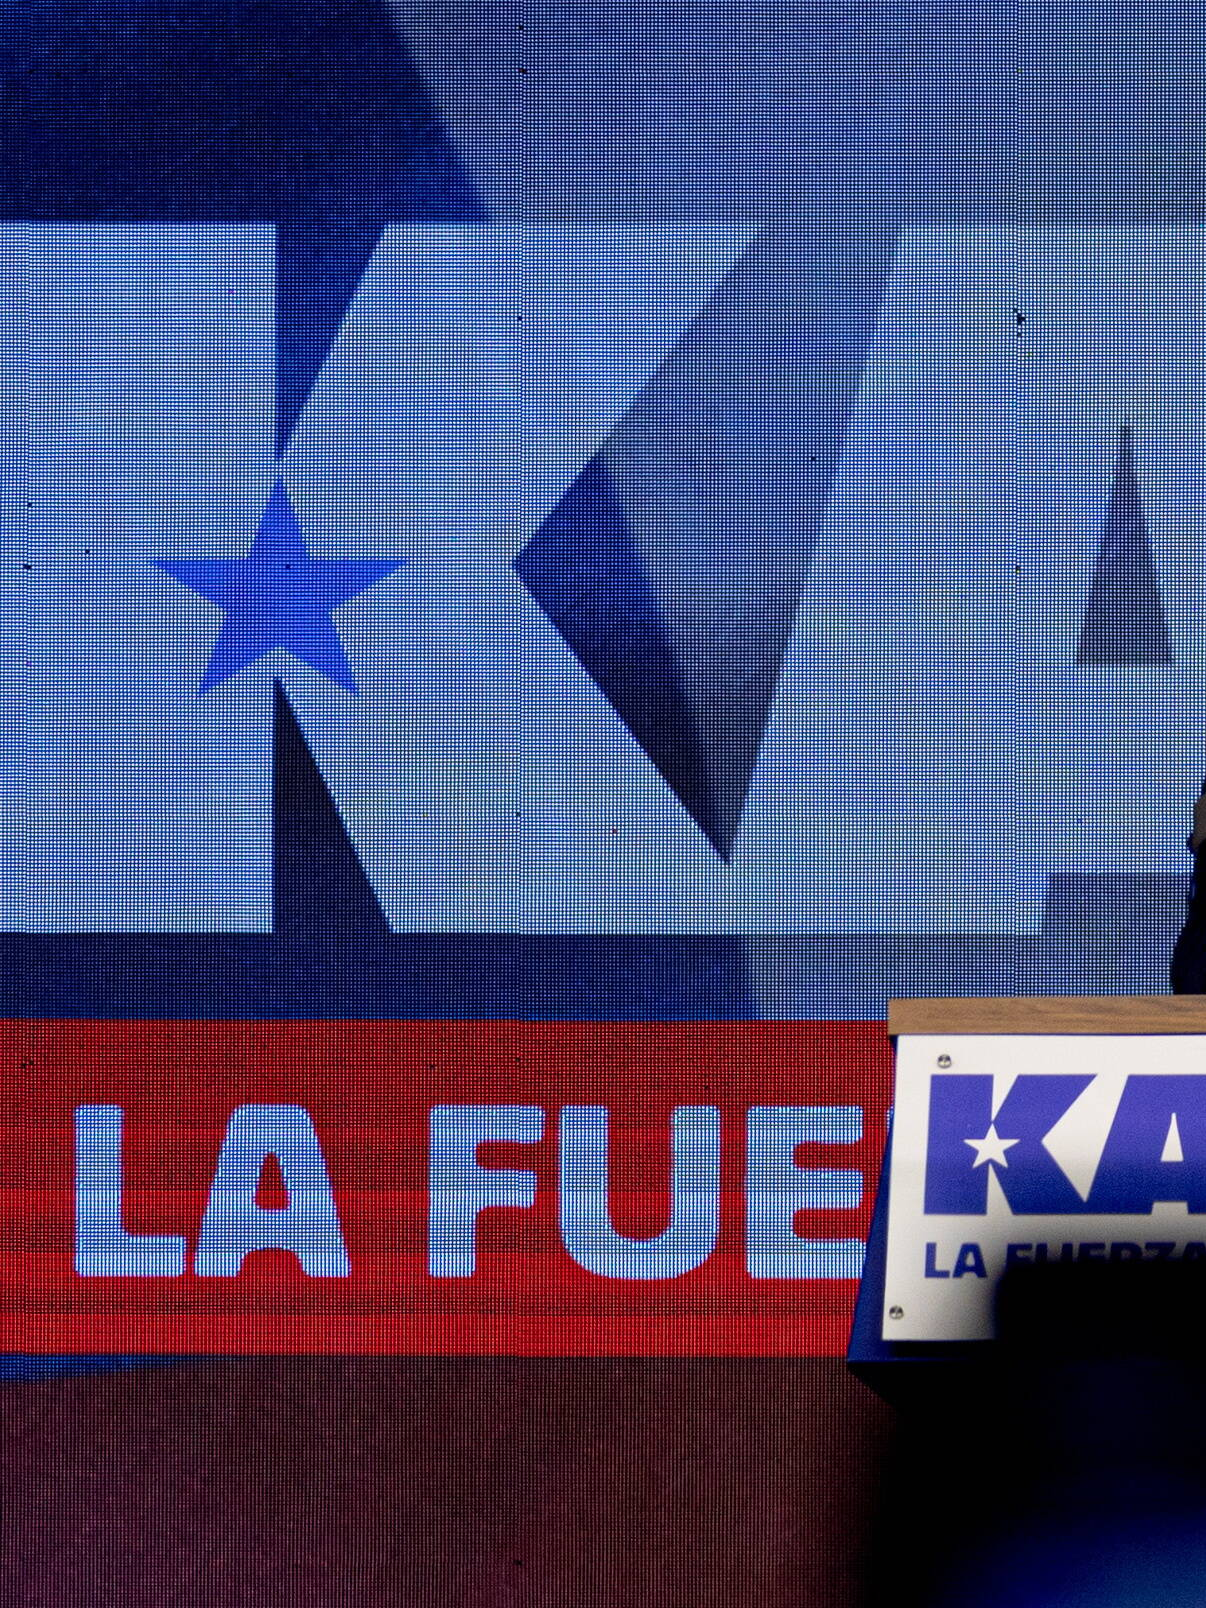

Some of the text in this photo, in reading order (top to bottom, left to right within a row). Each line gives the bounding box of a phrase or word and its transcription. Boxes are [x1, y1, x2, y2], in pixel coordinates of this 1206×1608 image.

[73, 1104, 352, 1278] LA
[428, 1105, 894, 1280] FUE
[924, 1242, 988, 1279] LA
